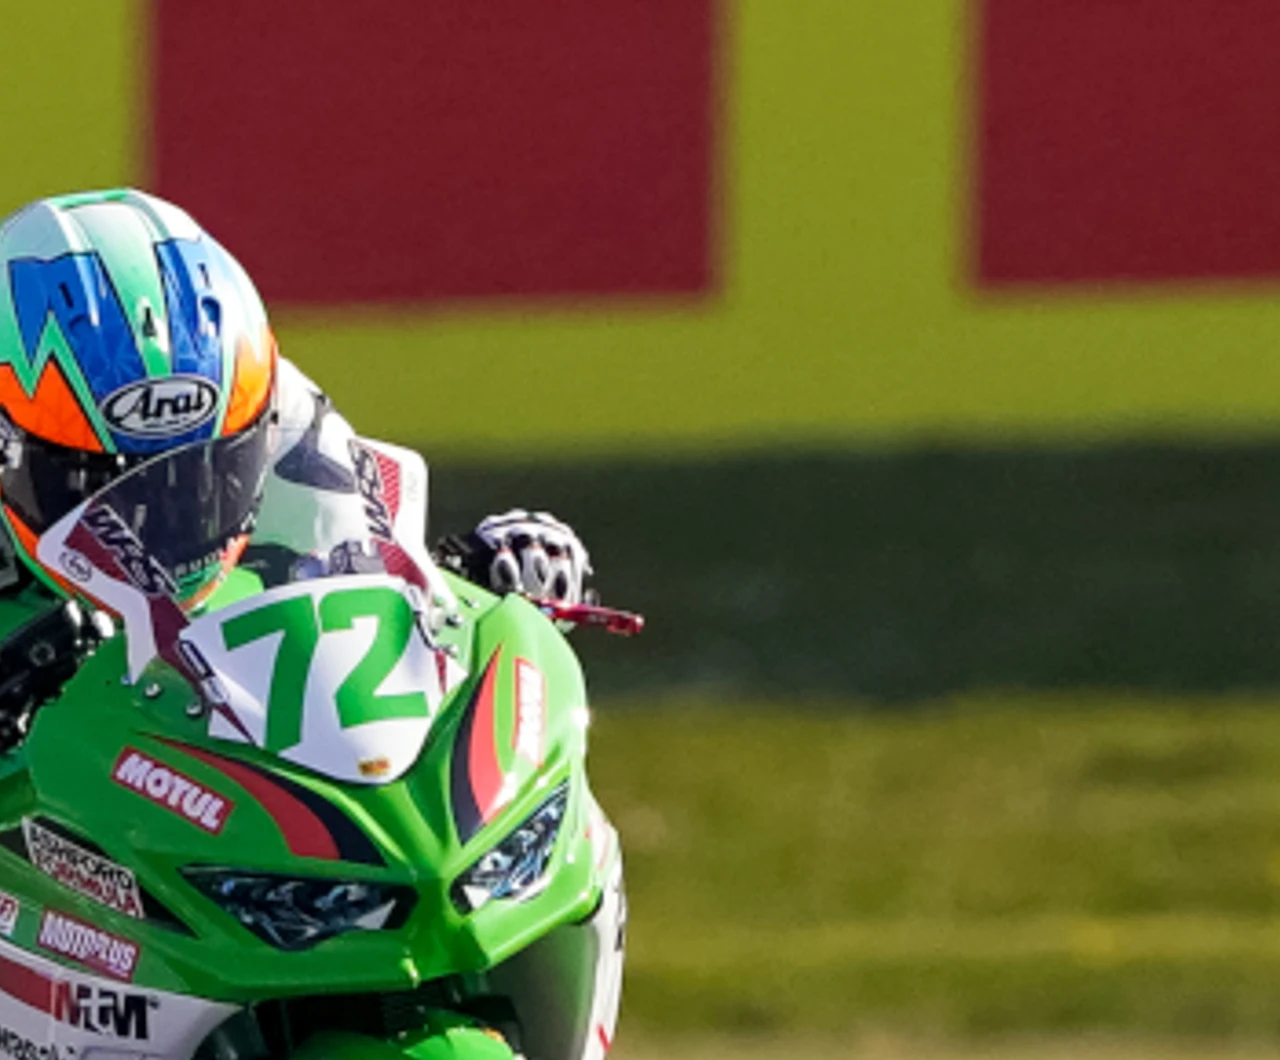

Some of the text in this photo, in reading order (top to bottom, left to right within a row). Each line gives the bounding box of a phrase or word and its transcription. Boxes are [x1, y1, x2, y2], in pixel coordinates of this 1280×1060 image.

[104, 381, 208, 422] Arai
[221, 586, 431, 752] 72
[115, 751, 227, 831] MOTUL
